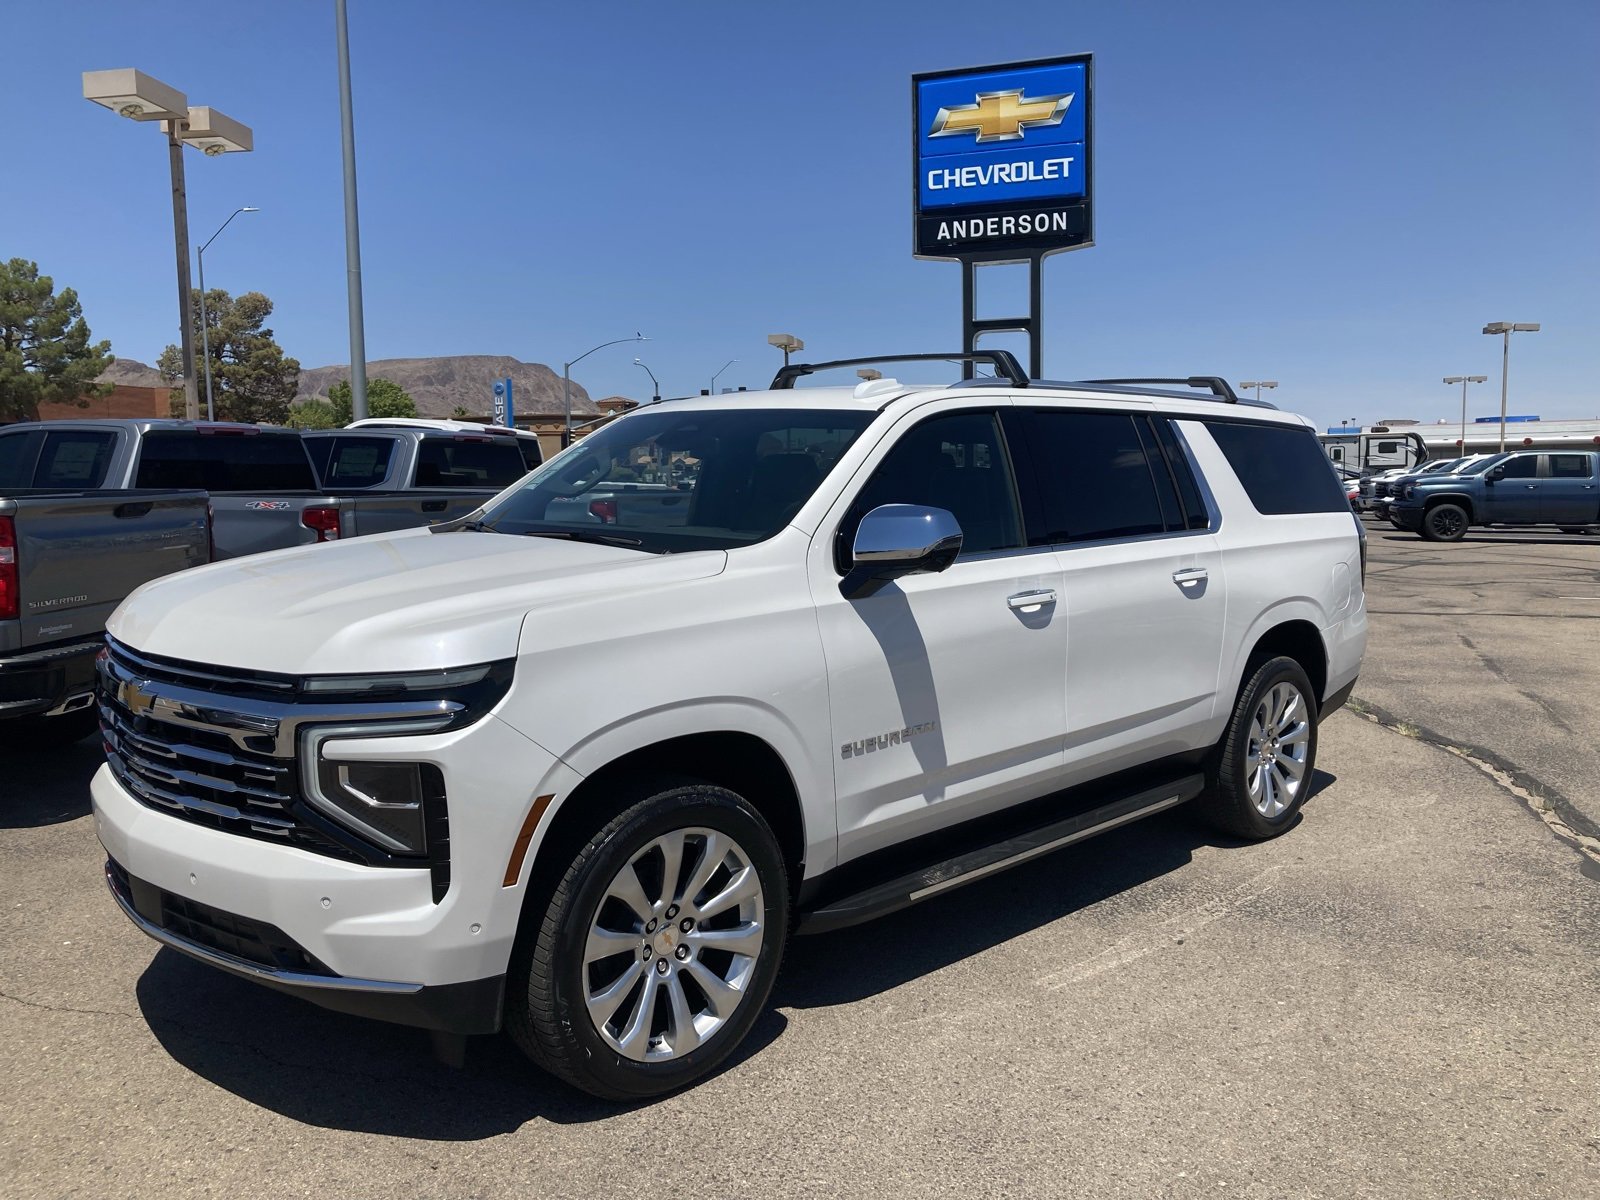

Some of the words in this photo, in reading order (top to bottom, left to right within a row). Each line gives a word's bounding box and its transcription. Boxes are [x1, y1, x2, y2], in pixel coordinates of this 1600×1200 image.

[928, 157, 1074, 190] CHEVROLET
[937, 211, 1067, 240] ANDERSON
[495, 396, 504, 426] ASE
[28, 594, 88, 609] SILVERADO
